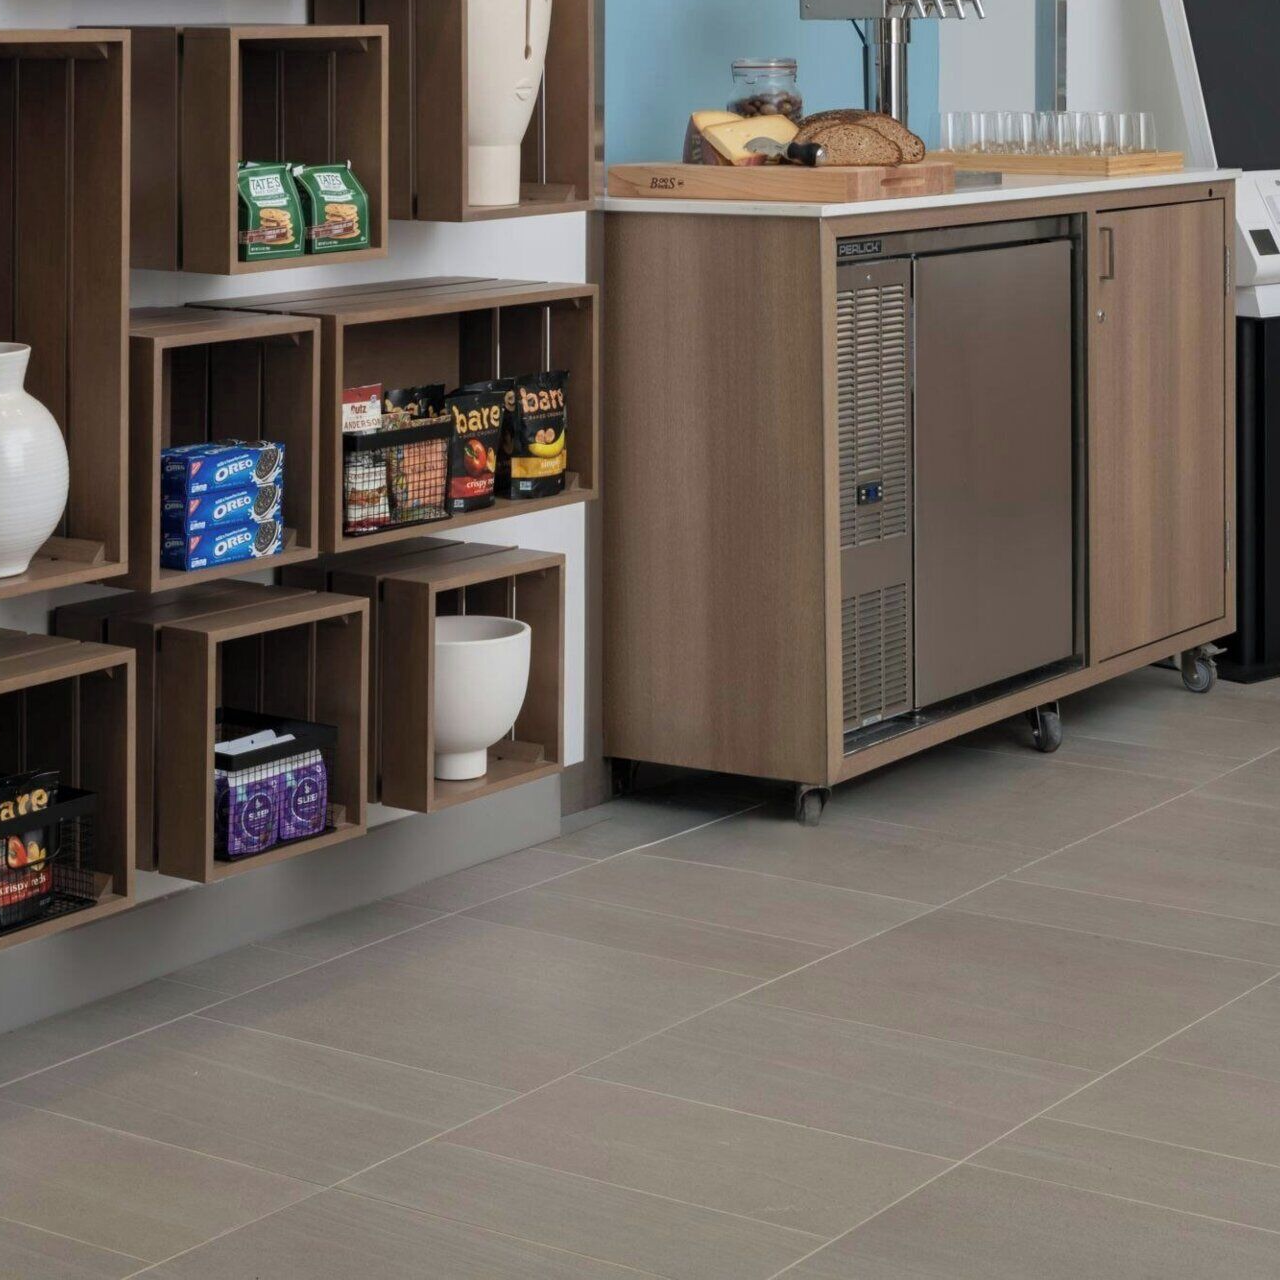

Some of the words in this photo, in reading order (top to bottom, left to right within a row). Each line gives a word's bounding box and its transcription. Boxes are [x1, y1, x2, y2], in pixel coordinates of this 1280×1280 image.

[250, 176, 281, 191] TATE'S
[317, 174, 341, 187] TATE'S
[839, 241, 880, 255] PERLICK
[452, 405, 500, 434] bare
[215, 458, 253, 482] OREO
[466, 479, 487, 489] crispy
[213, 495, 251, 519] OREO
[214, 532, 252, 556] OREO
